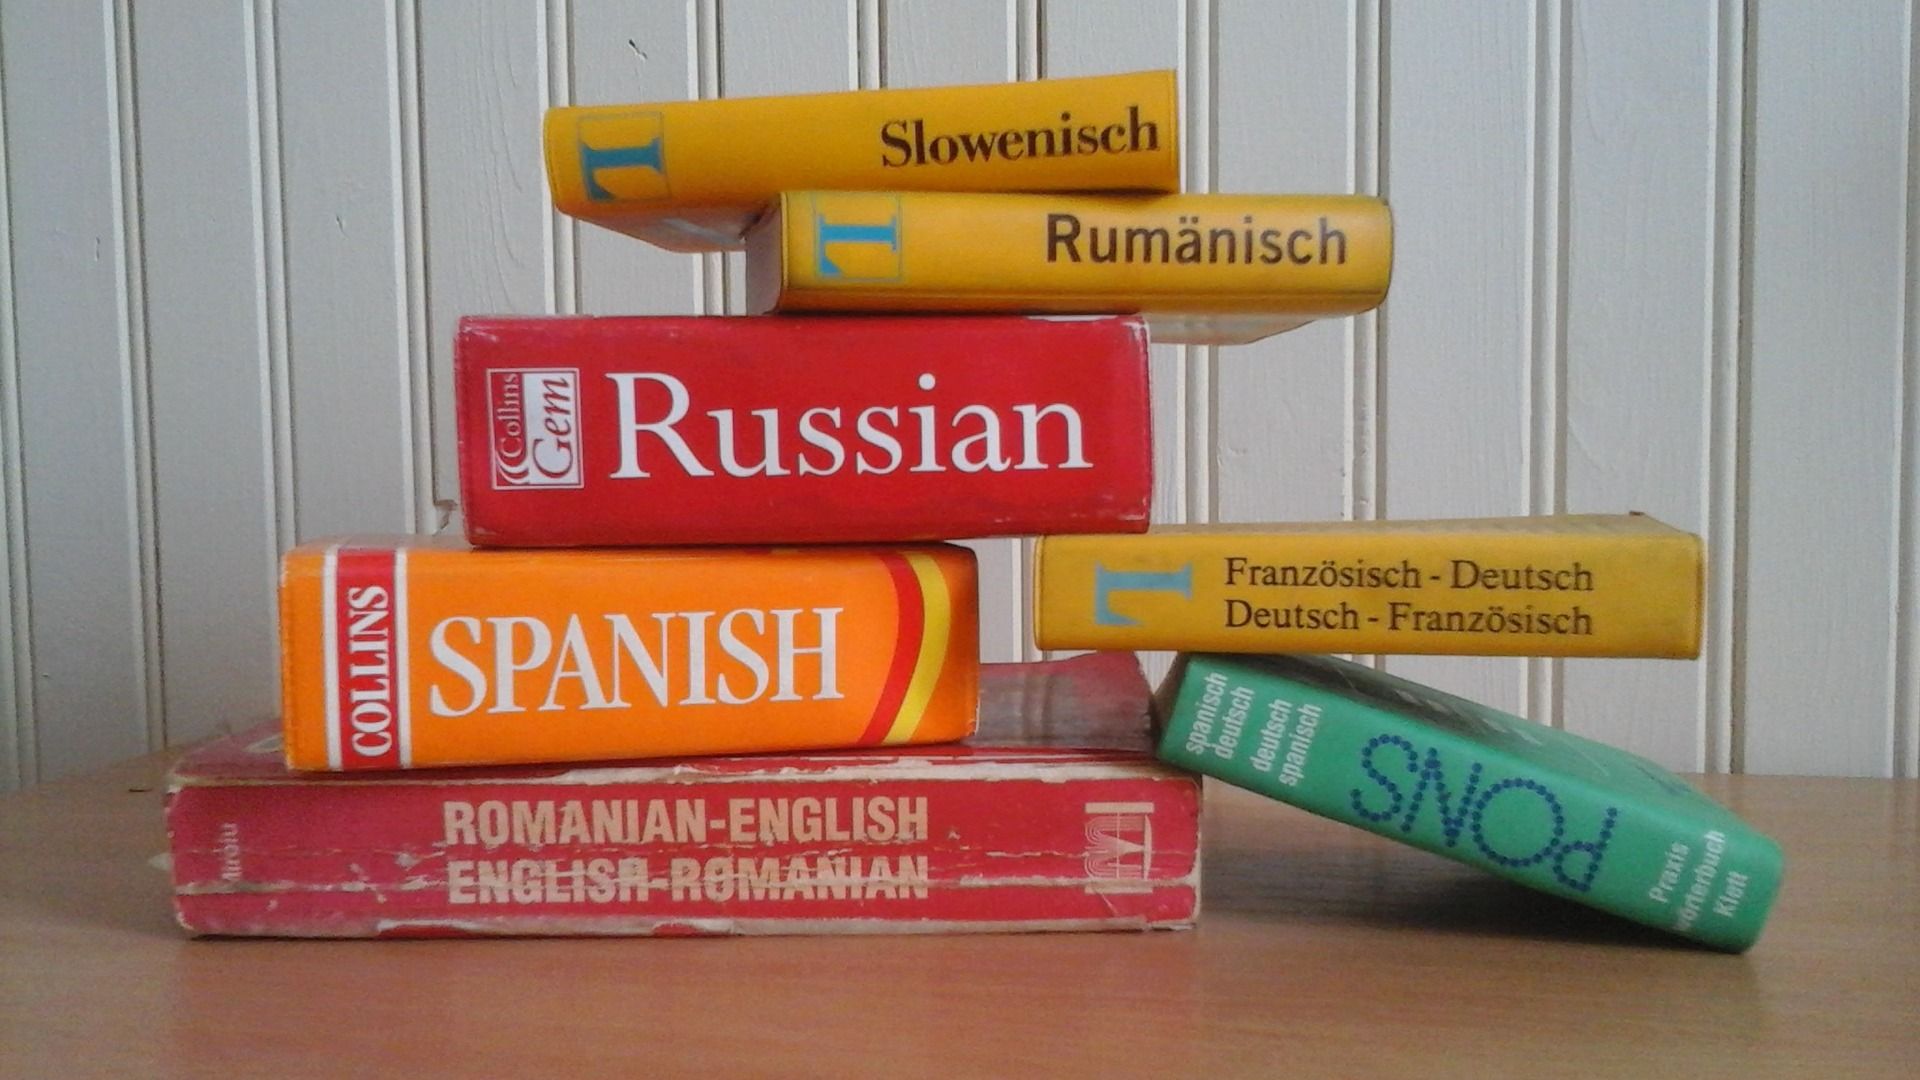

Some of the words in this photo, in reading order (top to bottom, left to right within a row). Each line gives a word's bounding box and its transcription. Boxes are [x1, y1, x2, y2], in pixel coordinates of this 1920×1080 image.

[881, 105, 1160, 169] Slowenisch
[1046, 213, 1347, 265] Rumänisch
[497, 373, 522, 458] Collins
[532, 377, 574, 479] Gem
[606, 372, 1093, 479] Russian
[1224, 557, 1422, 589] Französisch
[1450, 560, 1594, 592] Deutsch
[1224, 600, 1359, 630] Deutsch
[1387, 602, 1593, 636] Französisch
[349, 584, 394, 757] COLLINS
[428, 606, 846, 718] SPANISH
[1185, 672, 1228, 755] spanisch
[1211, 687, 1255, 760] deutsch
[1250, 698, 1293, 773] deutsch
[1279, 703, 1323, 787] spanisch
[443, 796, 928, 845] ROMANIAN-ENGLISH
[1350, 732, 1619, 892] PONS
[447, 855, 929, 906] ENGLISH-ROMANIAN
[1648, 842, 1690, 904] Praxis
